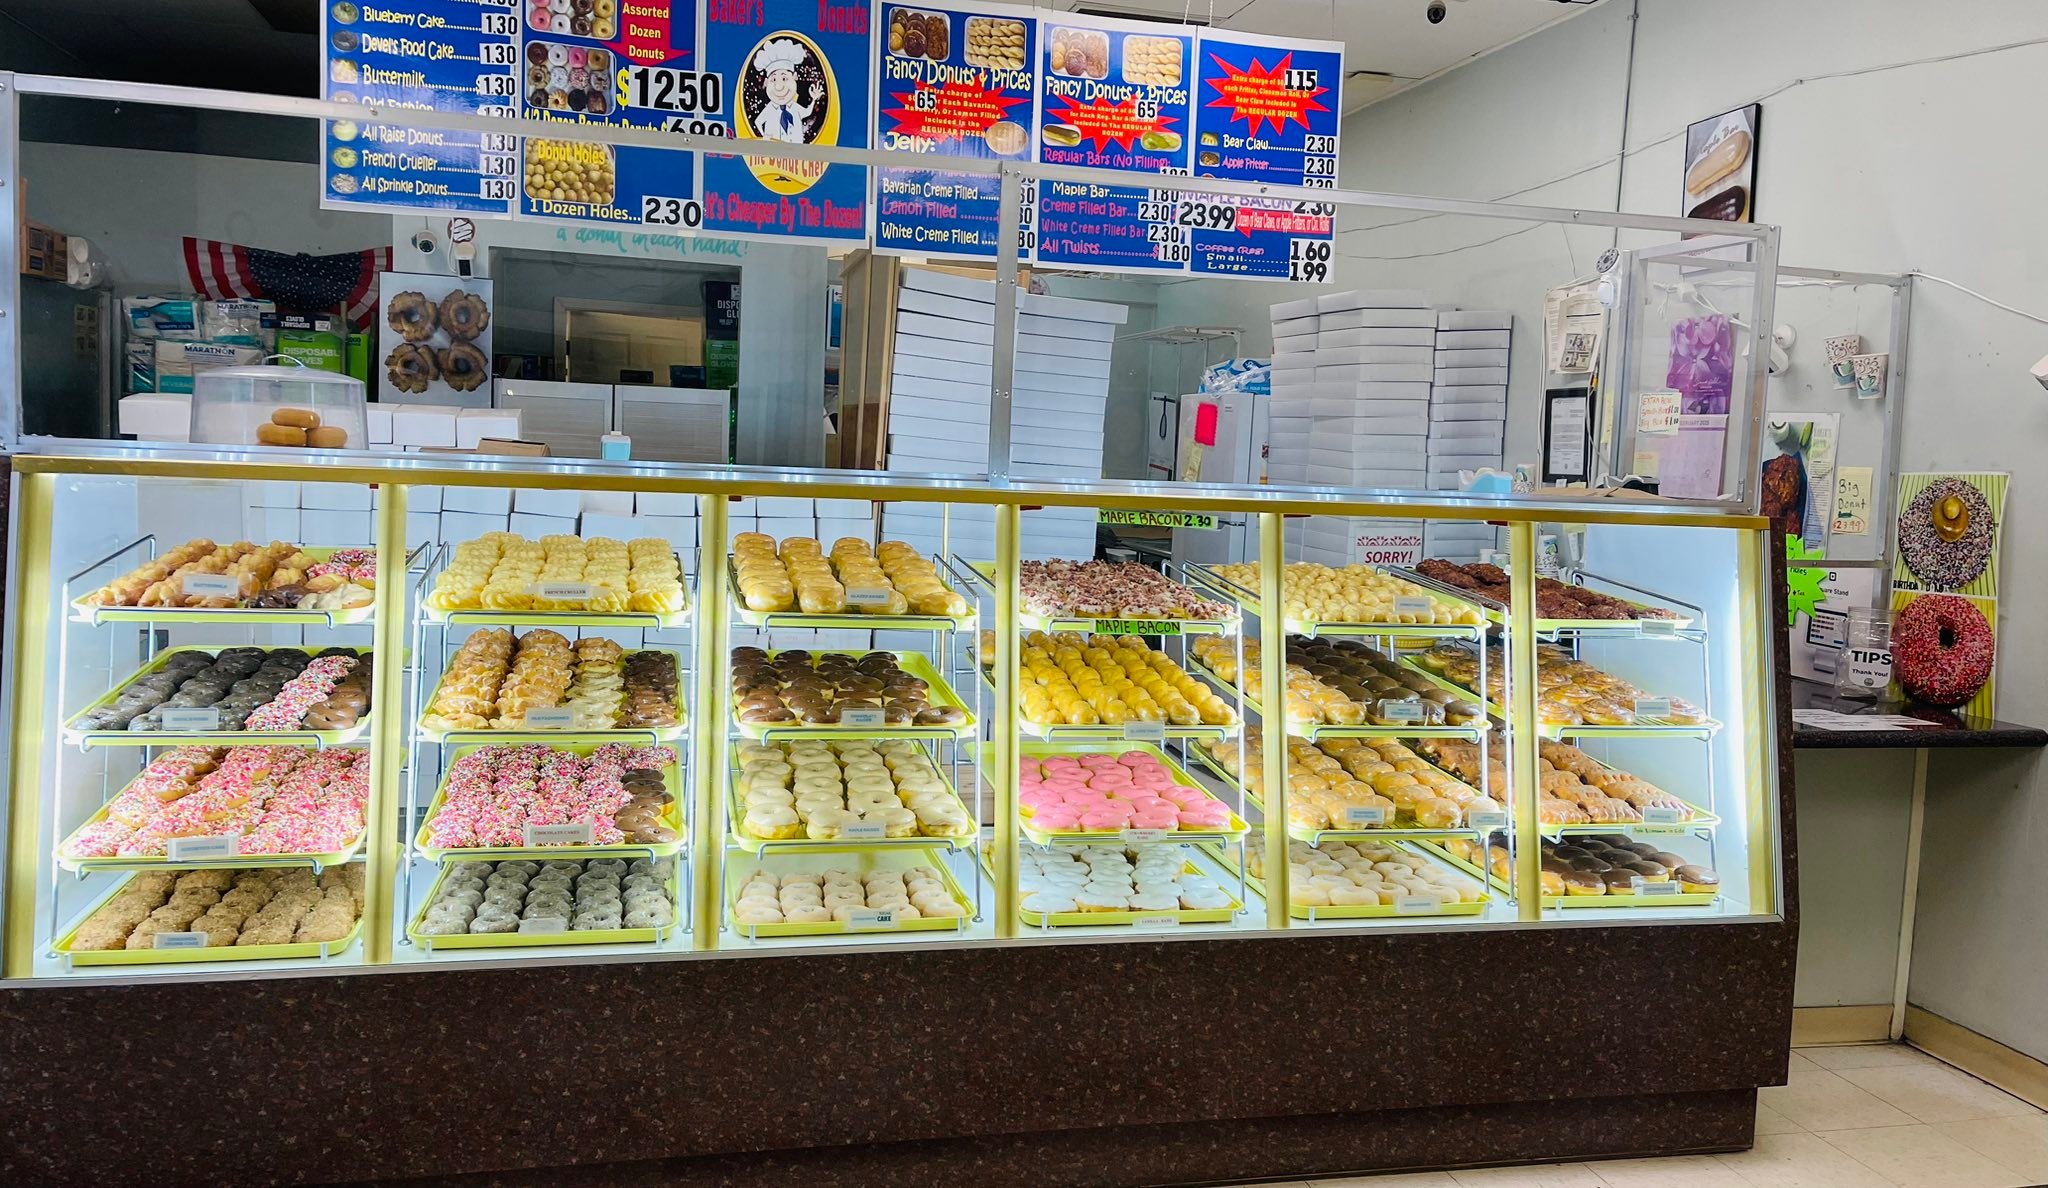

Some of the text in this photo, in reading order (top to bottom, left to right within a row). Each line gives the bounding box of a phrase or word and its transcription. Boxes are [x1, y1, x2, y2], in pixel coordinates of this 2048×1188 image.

[363, 6, 517, 34] Blueberry Cake 1.30
[623, 3, 669, 19] Assorted
[818, 0, 868, 35] Donuts
[629, 24, 661, 39] Dozen
[400, 38, 425, 56] Food
[429, 41, 454, 60] Cake
[484, 45, 516, 64] 1.30
[629, 45, 665, 60] Donuts
[363, 64, 515, 95] Buttermilk 1.30
[885, 55, 924, 82] Fancy
[927, 59, 976, 87] Donuts
[991, 65, 1032, 91] Prices
[917, 91, 936, 109] 65
[947, 89, 972, 98] charge
[1045, 76, 1082, 98] Fancy
[1085, 79, 1132, 101] Donuts
[1147, 85, 1187, 105] Prices
[953, 109, 977, 117] Lemon
[980, 112, 1000, 120] Filled
[1137, 102, 1155, 118] 65
[362, 124, 516, 151] All Raise Donuts 1.30
[884, 132, 936, 153] Jelly:
[1223, 134, 1335, 153] Bear Claw 2.30
[362, 150, 395, 168] French
[484, 157, 515, 175] 1.30
[538, 140, 605, 165] Donut Holes
[1043, 148, 1084, 165] Regular
[1087, 150, 1110, 165] Bars
[1113, 155, 1133, 168] (No
[1222, 157, 1244, 171] Apple
[1306, 158, 1334, 175] 2.30
[362, 176, 515, 199] All Sprinkle Donuts 1.30
[883, 178, 978, 200] Bavarian Creme Filled
[1052, 182, 1087, 197] Maple
[1090, 185, 1110, 198] Bar
[530, 199, 538, 213] 1
[543, 199, 586, 216] Dozen
[645, 198, 700, 227] 2.30
[705, 191, 864, 233] It's Cheaper By The Dozen!
[882, 196, 956, 219] Lemon Filled
[1041, 198, 1169, 221] Creme Filled Bar 2.30
[1179, 202, 1235, 229] 23.99
[881, 222, 978, 245] White Creme Filled
[1041, 218, 1179, 243] White Creme Filled Bar 2.30
[1040, 237, 1058, 254] All
[1062, 239, 1100, 255] Twists
[1195, 243, 1264, 255] Coffee (Reg)
[1207, 241, 1330, 262] Small 1.60
[1207, 262, 1327, 283] Large 1.99
[184, 345, 235, 355] MARATHON
[1839, 479, 1859, 497] Big
[1838, 499, 1866, 510] Donut
[1139, 512, 1182, 527] BACON
[1184, 515, 1211, 526] 2.30
[1365, 551, 1413, 564] SORRY!
[1138, 621, 1180, 634] BACON
[1851, 650, 1892, 665] TIPS
